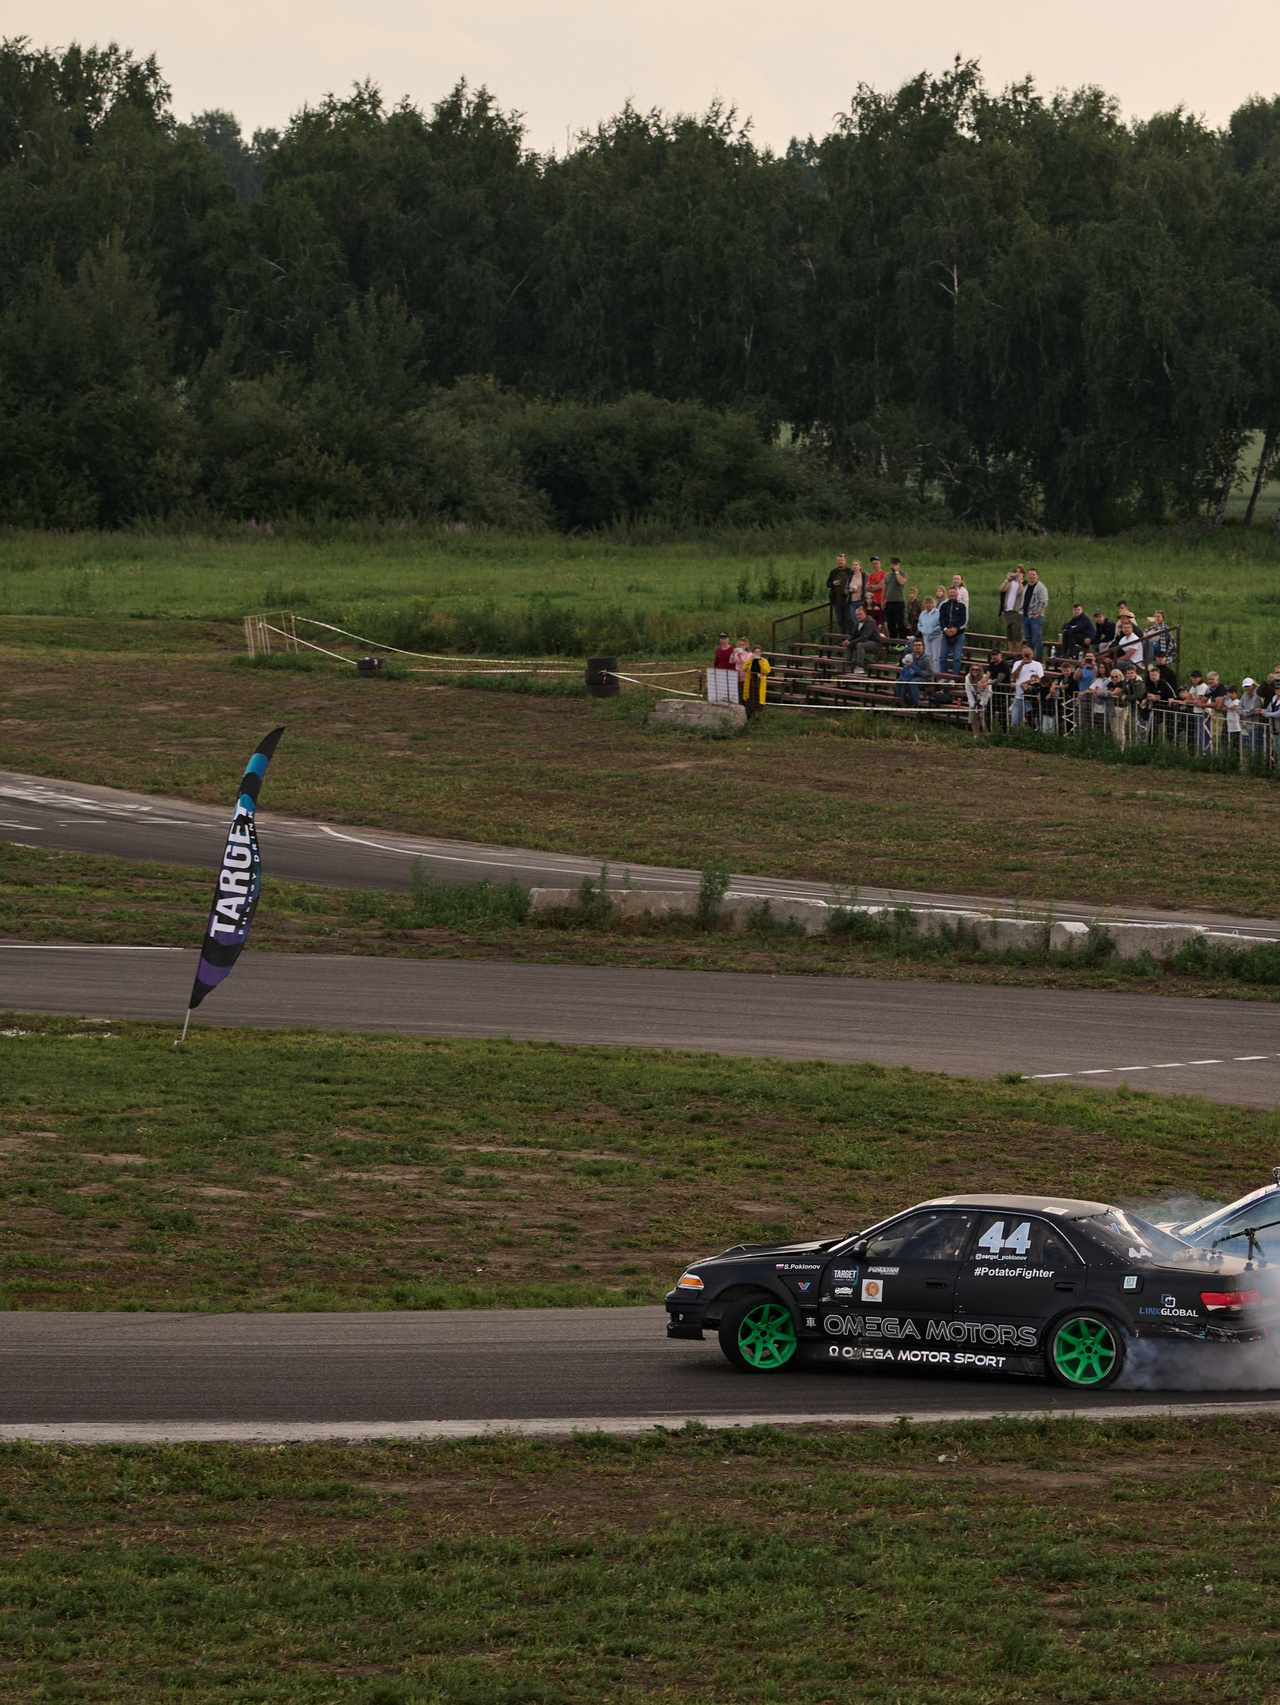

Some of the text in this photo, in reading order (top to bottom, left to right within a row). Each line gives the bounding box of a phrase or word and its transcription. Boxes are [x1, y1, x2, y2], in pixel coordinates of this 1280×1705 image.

[246, 811, 260, 863] DRINK
[210, 799, 251, 937] TARGET
[978, 1221, 1031, 1254] 44
[1129, 1247, 1153, 1259] 44
[834, 1270, 857, 1279] TARGET
[974, 1267, 1055, 1279] #PotatoFighter
[1139, 1307, 1199, 1317] LINKGLOBAL
[824, 1315, 1038, 1347] OMEGA MOTORS
[898, 1350, 950, 1363] MOTOR
[954, 1353, 1006, 1368] SPORT
